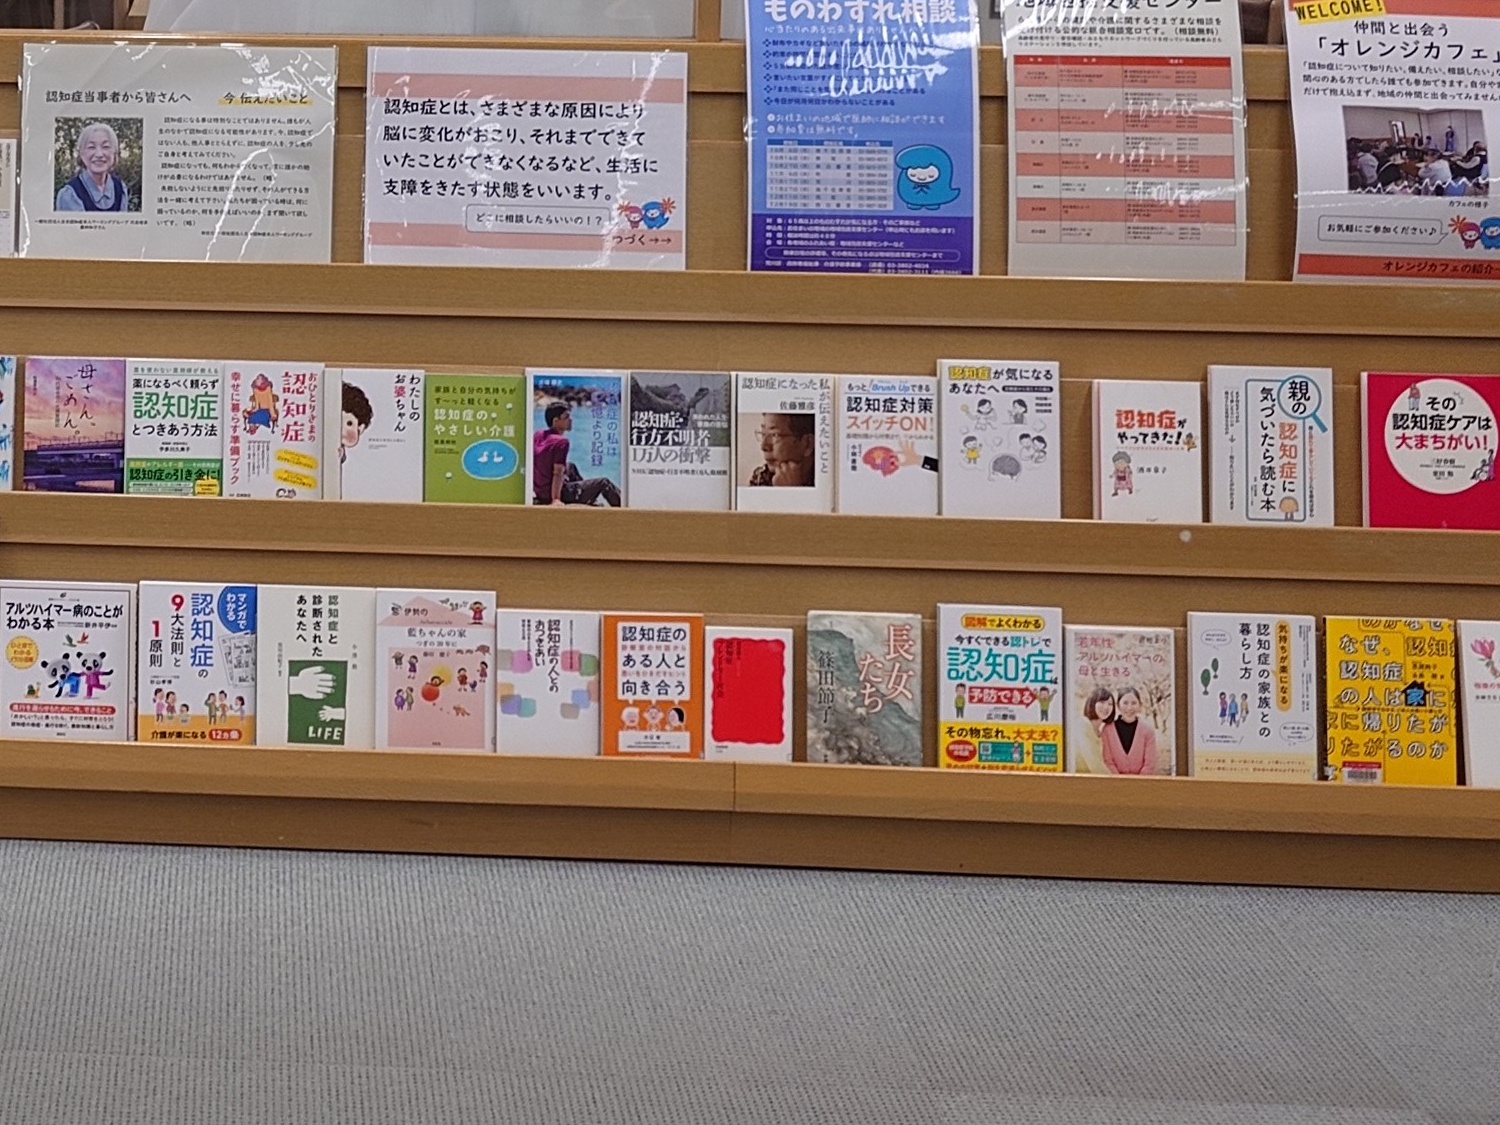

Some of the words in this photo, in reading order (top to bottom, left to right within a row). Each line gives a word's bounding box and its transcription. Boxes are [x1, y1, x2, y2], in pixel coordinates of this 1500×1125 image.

[1354, 21, 1449, 37] 仲間と出会う
[46, 90, 192, 104] 認知症当事者から皆さんへ
[224, 92, 234, 105] 今
[384, 97, 643, 120] 認知症とは、さまざまな原因により
[383, 125, 646, 147] 脳に変化がおこり、それまでできて
[384, 153, 658, 175] いたことができなくなるなど、生活に
[383, 179, 612, 201] 支障をきたす状態をいいます。
[949, 366, 1053, 381] 認知症が気になる
[132, 378, 219, 390] 薬になるべく頼らず
[949, 383, 1000, 395] あなたへ
[132, 391, 219, 420] 認知症
[281, 371, 307, 443] 認知症
[409, 374, 421, 422] わたしの
[846, 397, 933, 413] 認知症対策
[1425, 396, 1457, 412] その
[434, 409, 488, 420] 認知症の
[1115, 409, 1187, 429] 認知症が
[1392, 413, 1492, 431] 認知症ケアは
[132, 423, 218, 438] とつきあう方法
[434, 425, 516, 438] やさしい介護
[631, 428, 711, 446] 行方不明者
[1260, 387, 1276, 513] 気づいたら読む本
[5, 602, 123, 617] アルツハイマー病のことが
[226, 592, 237, 622] わかる
[6, 617, 55, 630] わかる本
[296, 595, 307, 643] あなたへ
[311, 594, 324, 658] 診断された
[327, 595, 339, 645] 認知症と
[190, 593, 215, 678] 認知症の
[534, 620, 545, 667] おつきあい
[621, 626, 687, 641] 認知症の
[547, 619, 560, 693] 認知症の人との
[621, 653, 686, 669] ある人と
[1239, 622, 1252, 680] 暮らし方
[885, 624, 915, 700] 長女
[946, 646, 1058, 685] 認知症は
[1078, 666, 1131, 678] 母と生きる
[1339, 661, 1403, 681] 認知症
[621, 679, 686, 696] 向き合う
[859, 653, 883, 713] たち
[1256, 623, 1271, 738] 認知症の家族との
[968, 688, 1034, 704] 予防できる
[308, 725, 344, 741] LIFE
